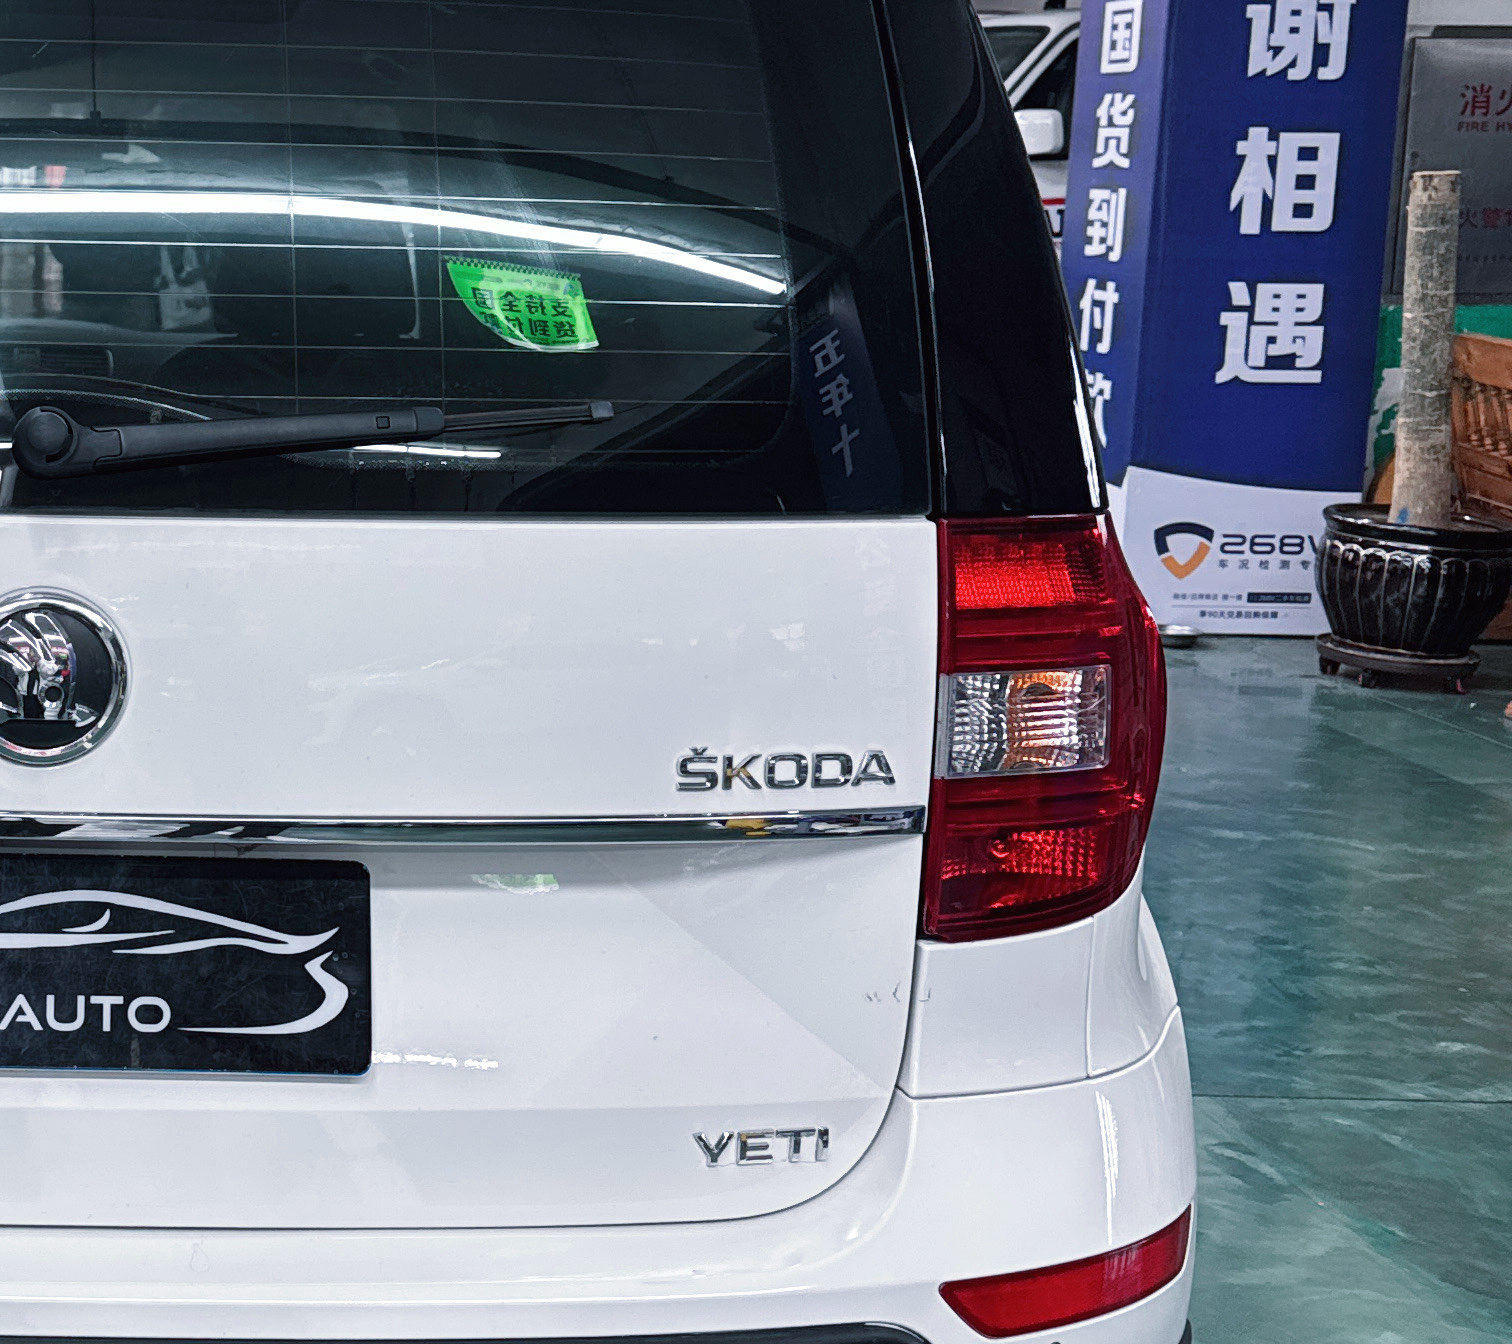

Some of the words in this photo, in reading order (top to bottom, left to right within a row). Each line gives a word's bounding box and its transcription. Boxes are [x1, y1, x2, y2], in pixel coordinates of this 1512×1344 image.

[1457, 121, 1488, 132] FIRE
[675, 746, 896, 792] ŠKODA
[692, 1125, 829, 1167] YETI
